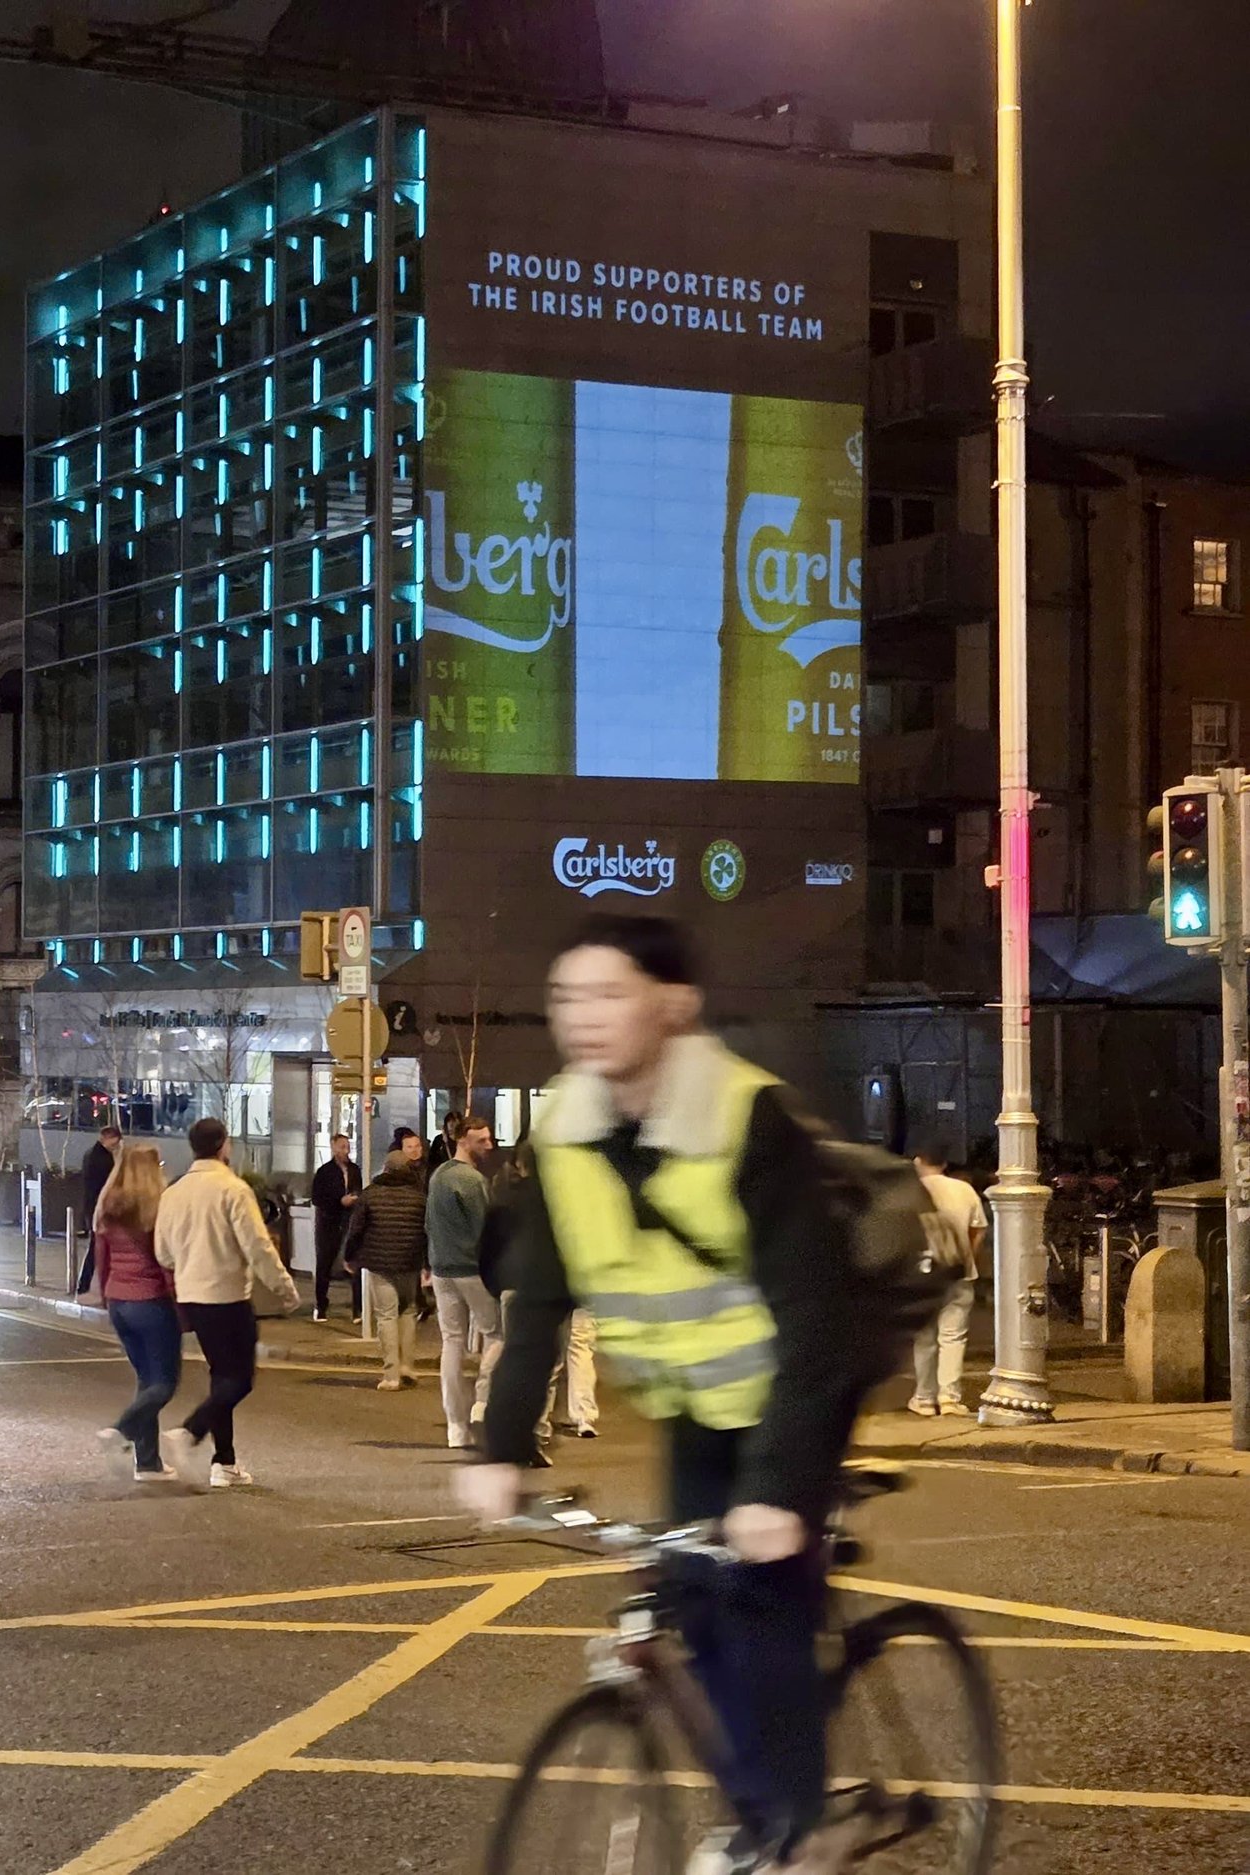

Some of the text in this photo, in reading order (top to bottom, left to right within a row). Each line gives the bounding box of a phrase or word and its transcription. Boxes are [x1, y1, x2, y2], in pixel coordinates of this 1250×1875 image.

[489, 251, 805, 306] PROUD SUPPORTERS OF
[468, 283, 822, 341] THE IRISH FOOTBALL TEAM
[830, 671, 861, 690] DA
[428, 694, 518, 733] NER
[553, 837, 676, 890] Carlsberg
